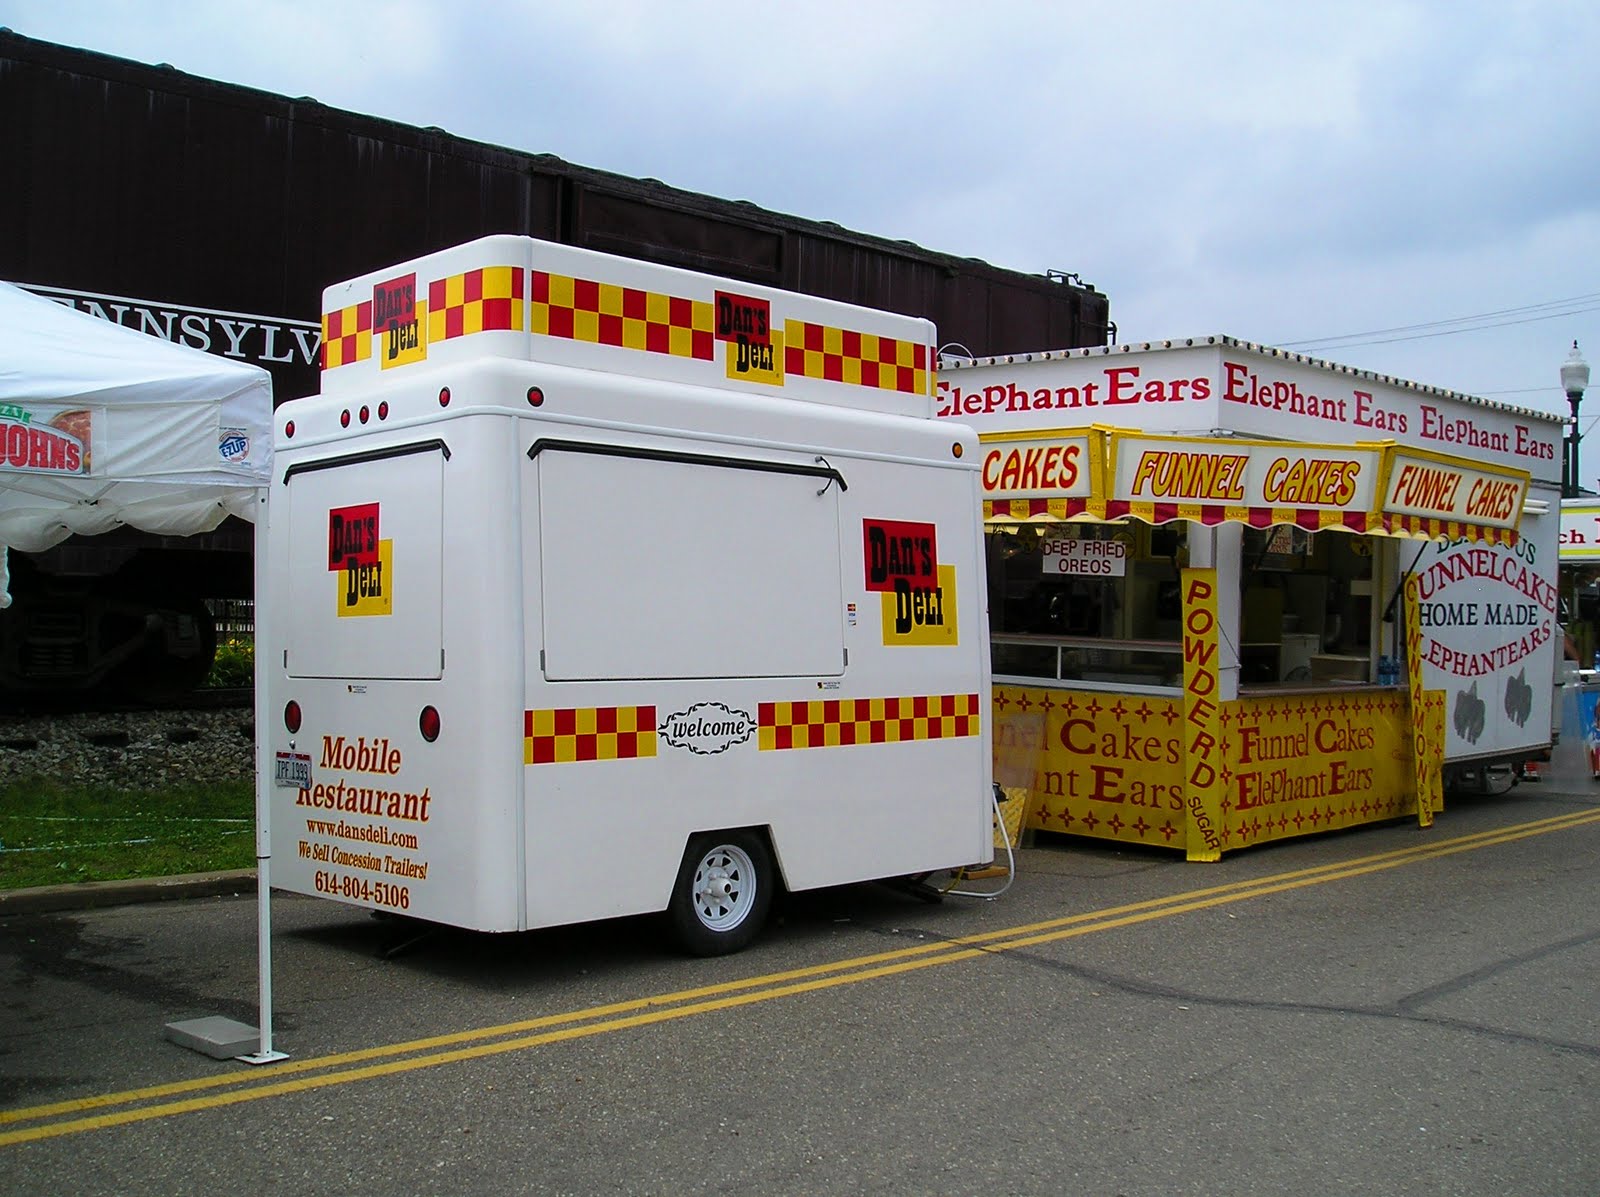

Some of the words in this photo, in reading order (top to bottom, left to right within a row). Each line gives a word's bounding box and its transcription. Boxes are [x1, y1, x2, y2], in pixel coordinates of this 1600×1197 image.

[51, 297, 322, 365] NSYLV
[1103, 367, 1211, 405] Ears
[1353, 390, 1407, 433] Ears
[1514, 425, 1554, 460] Ears
[982, 445, 1080, 491] CAKES
[1131, 450, 1250, 501] FUNNEL
[1263, 458, 1361, 506] CAKES
[1391, 465, 1462, 512] FUNNEL
[1466, 478, 1519, 520] CAKES
[1043, 540, 1077, 556] DEEP
[1083, 542, 1125, 559] FRIED
[1058, 558, 1112, 574] OREOS
[1419, 603, 1478, 626] HOME
[1484, 603, 1538, 626] MADE
[1184, 579, 1217, 789] POWDERD
[1406, 580, 1428, 785] CINNAMON
[673, 717, 745, 738] welcome
[1060, 718, 1180, 764] Cakes
[1238, 721, 1309, 764] Funnel
[1315, 719, 1374, 753] Cakes
[320, 736, 401, 775] Mobile
[296, 777, 431, 822] Restaurant
[1089, 765, 1184, 811] Ears
[1328, 761, 1374, 796] Ears
[307, 819, 418, 849] www.dansdeli.com
[1188, 796, 1221, 850] SUGAR
[299, 840, 311, 859] We
[312, 843, 329, 862] Sell
[332, 846, 382, 872] Concession
[384, 855, 428, 880] Trailers!
[315, 870, 409, 910] 614-804-5106
